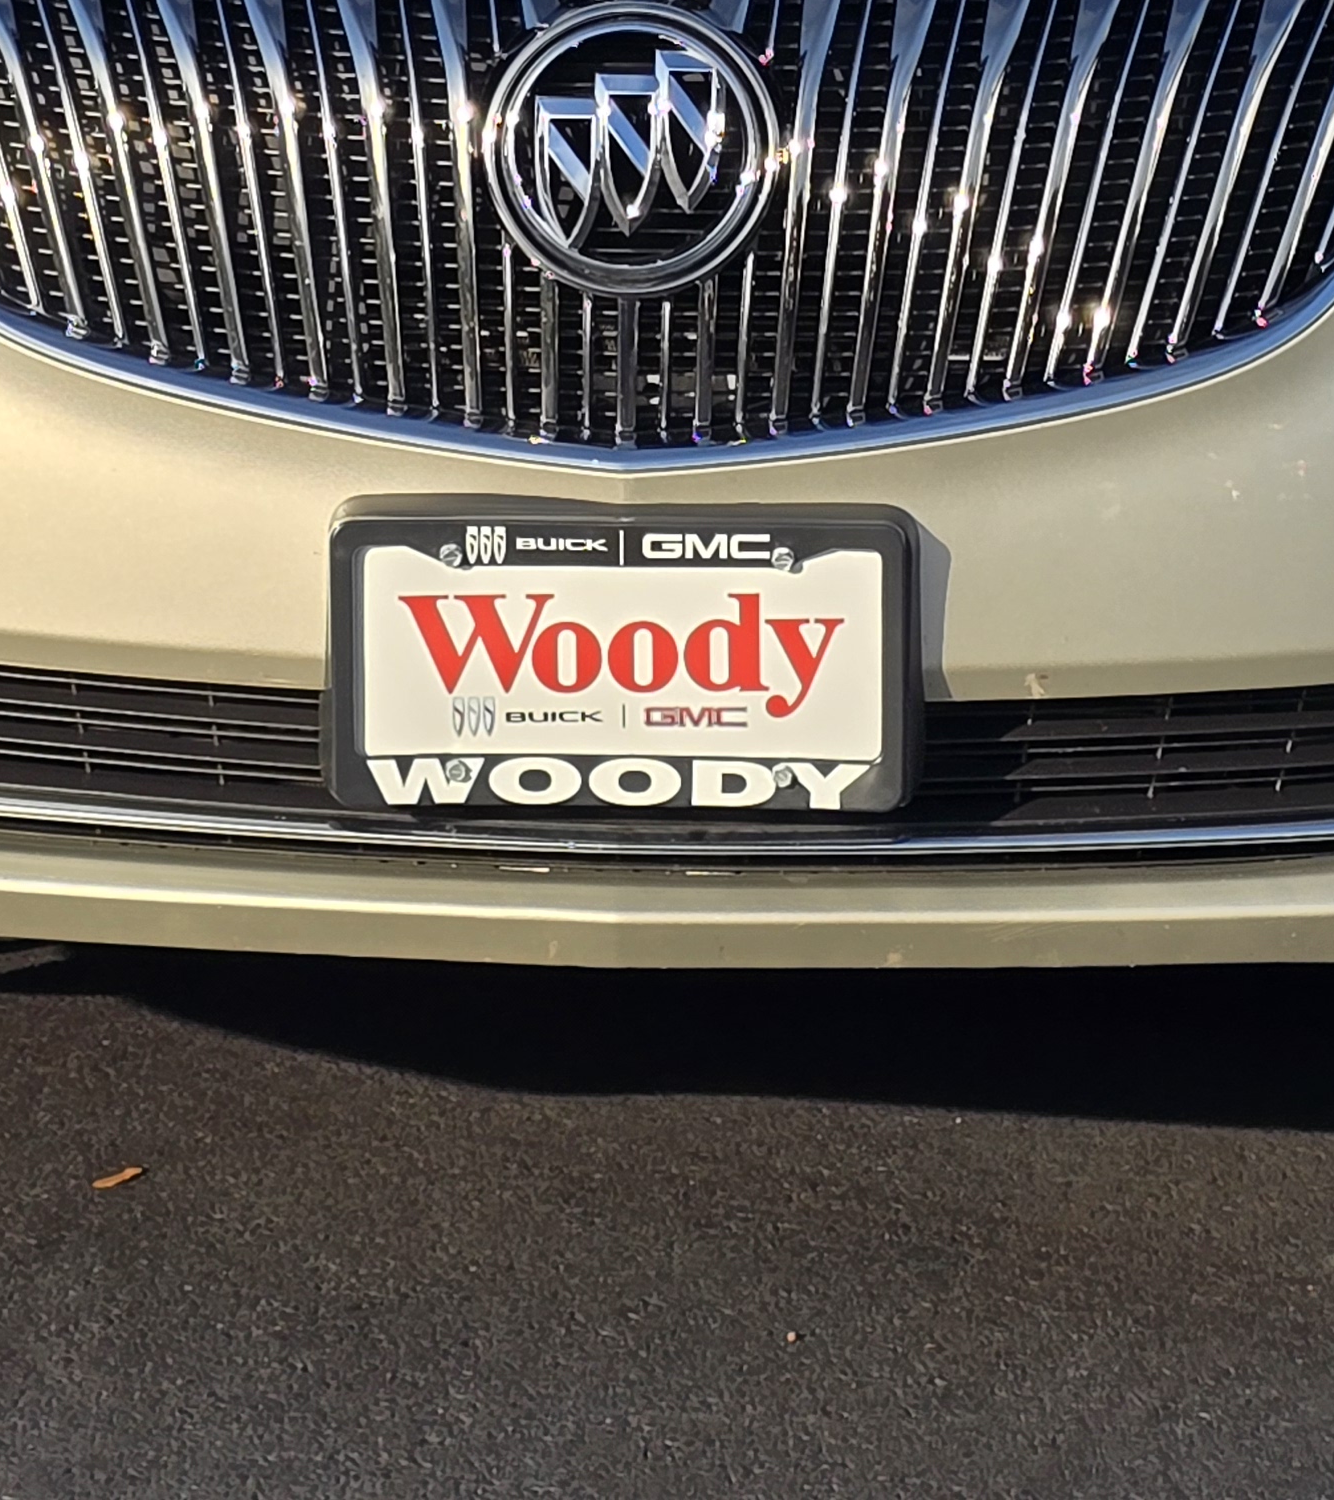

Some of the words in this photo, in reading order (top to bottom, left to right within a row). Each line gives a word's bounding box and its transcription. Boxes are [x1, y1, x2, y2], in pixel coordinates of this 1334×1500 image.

[515, 536, 609, 552] BUICK
[641, 532, 771, 560] GMC
[398, 592, 845, 719] Woody
[505, 710, 603, 723] BUICK
[644, 706, 749, 728] GMC
[366, 757, 873, 811] WOODY
